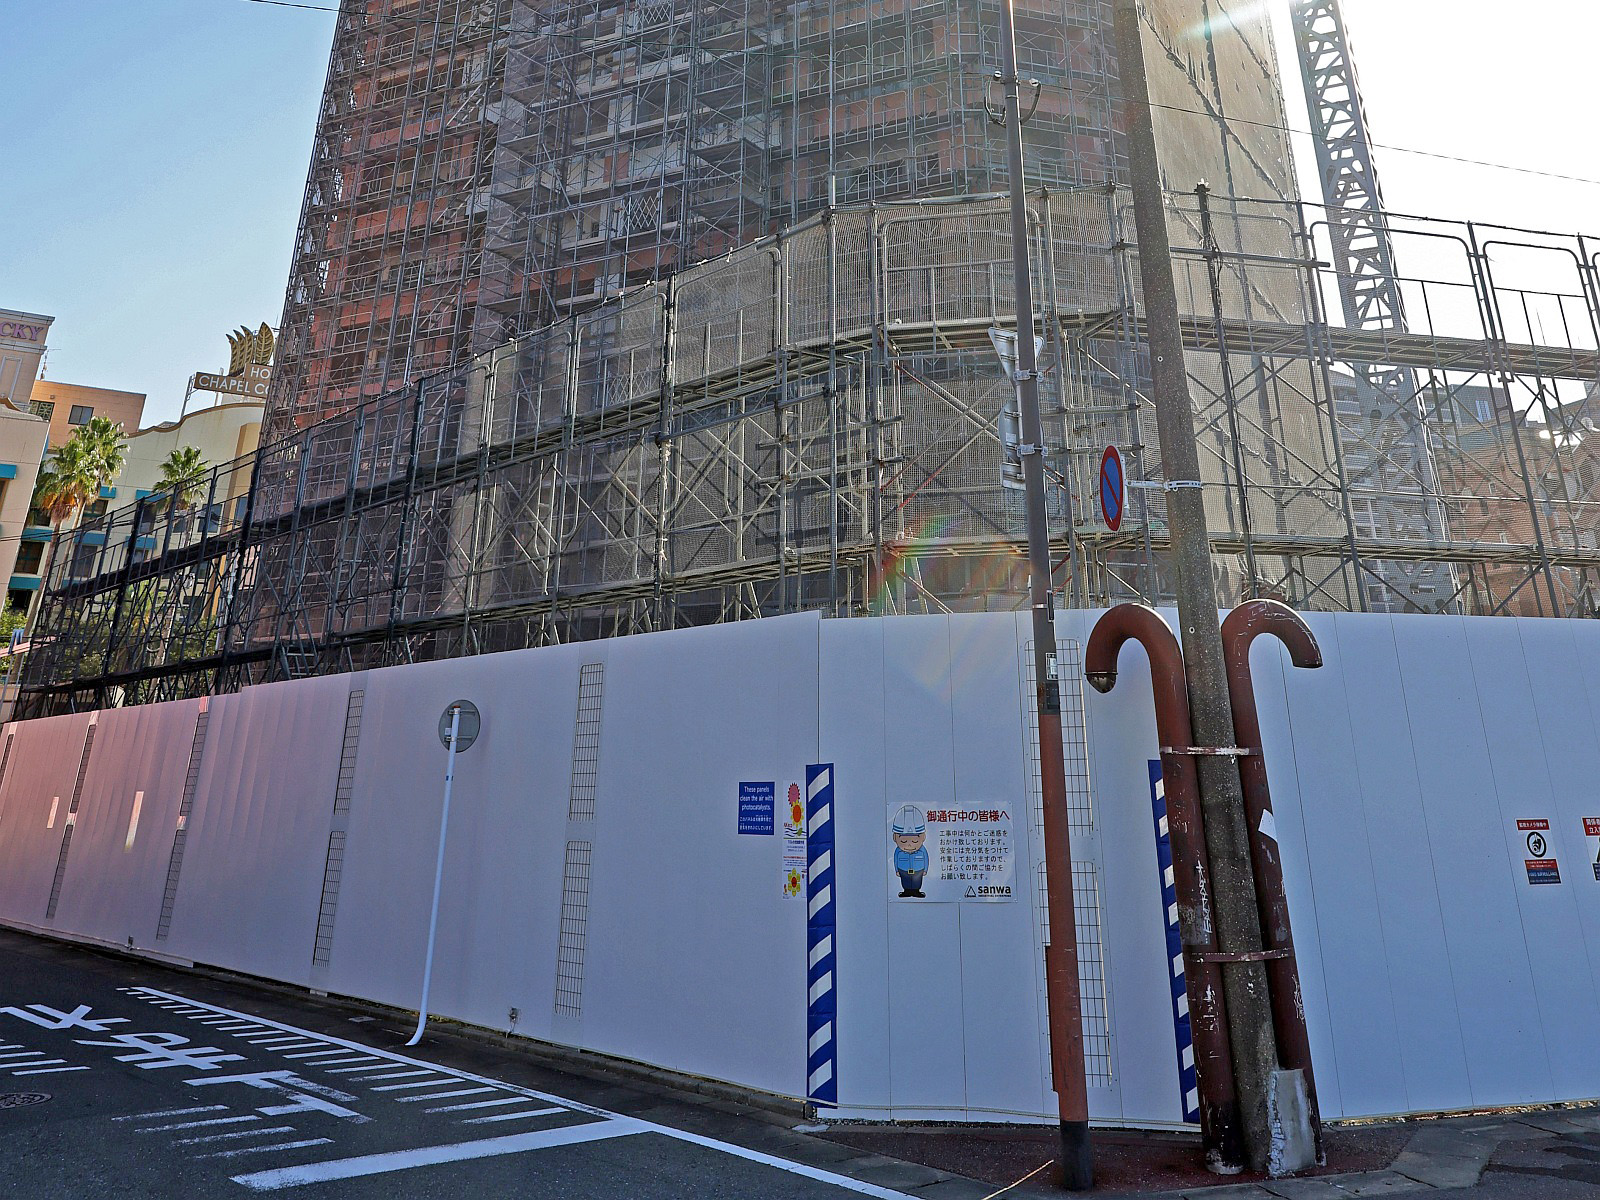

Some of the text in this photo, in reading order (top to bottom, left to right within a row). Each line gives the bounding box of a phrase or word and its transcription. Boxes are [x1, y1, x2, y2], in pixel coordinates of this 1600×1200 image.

[0, 321, 44, 342] CKY
[198, 375, 251, 393] CHAPEL
[757, 786, 770, 794] panels
[926, 809, 1010, 823] 御通行中の皆様へ
[939, 829, 1008, 837] 工事中は何かとご迷惑を
[939, 838, 1006, 846] おかけ致しております。
[940, 847, 1009, 855] 安全には充分気をつけて
[940, 855, 1007, 863] 作業しておりますので、
[941, 864, 1004, 872] しばらくの間ご協力を
[941, 872, 989, 881] お願い致します。
[977, 885, 1012, 895] sanwa
